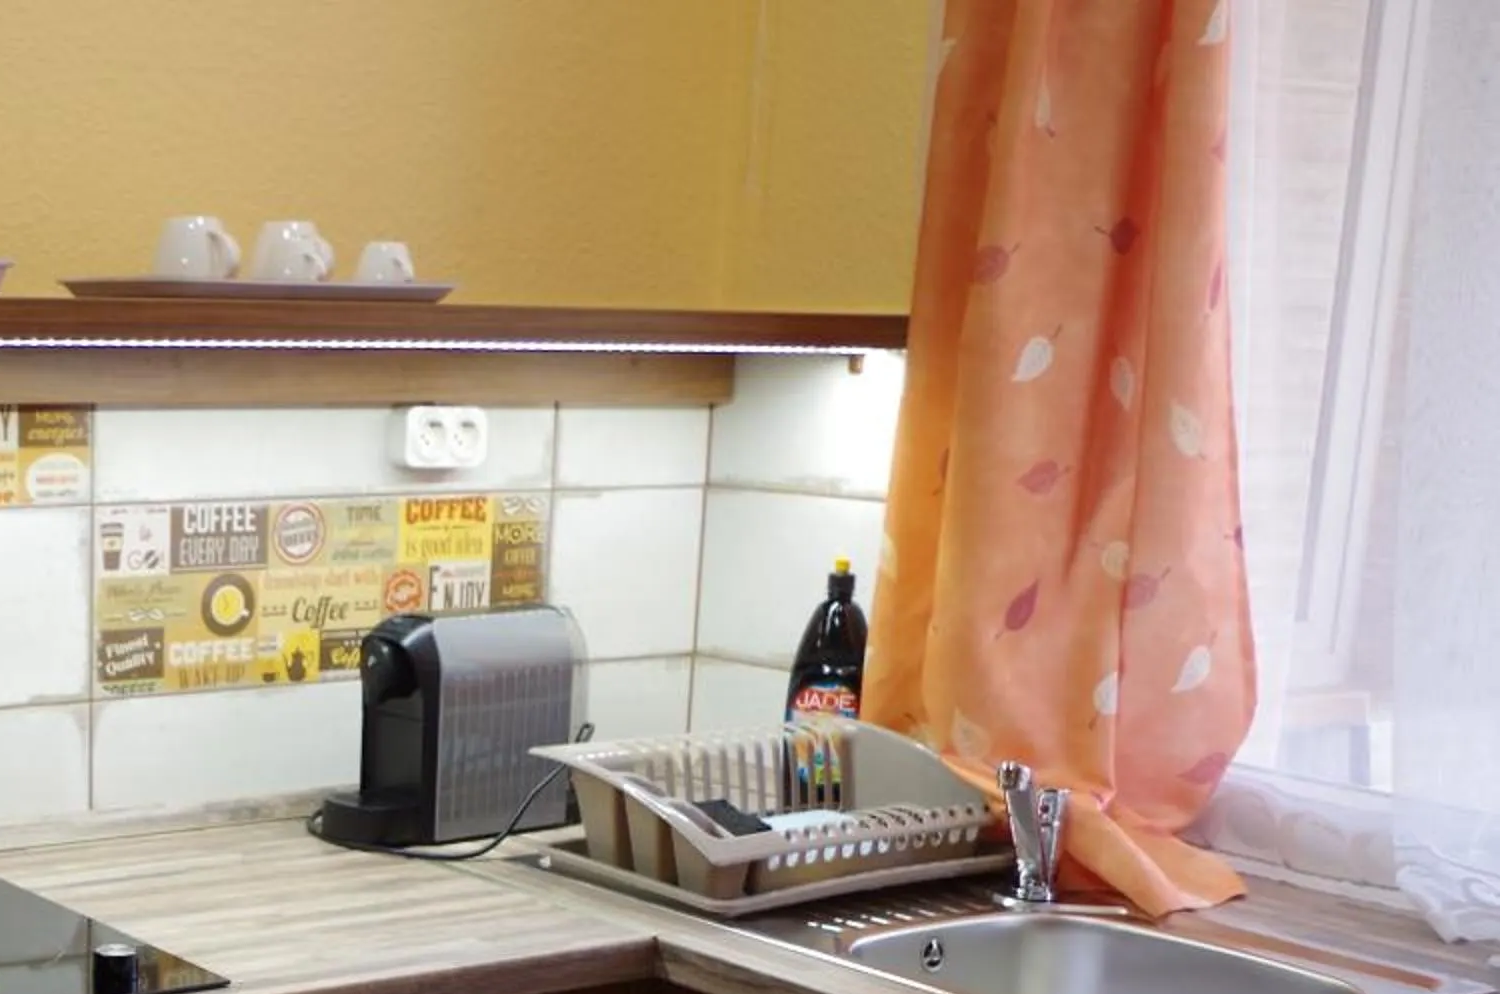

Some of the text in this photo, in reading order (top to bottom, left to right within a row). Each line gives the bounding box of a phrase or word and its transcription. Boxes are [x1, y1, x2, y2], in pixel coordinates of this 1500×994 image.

[183, 502, 257, 534] COFFEE
[405, 496, 486, 525] COFFEE
[180, 535, 259, 566] EVERY DAY
[292, 595, 348, 628] Coffee
[170, 637, 255, 666] COFFEE
[795, 690, 857, 710] JADE
